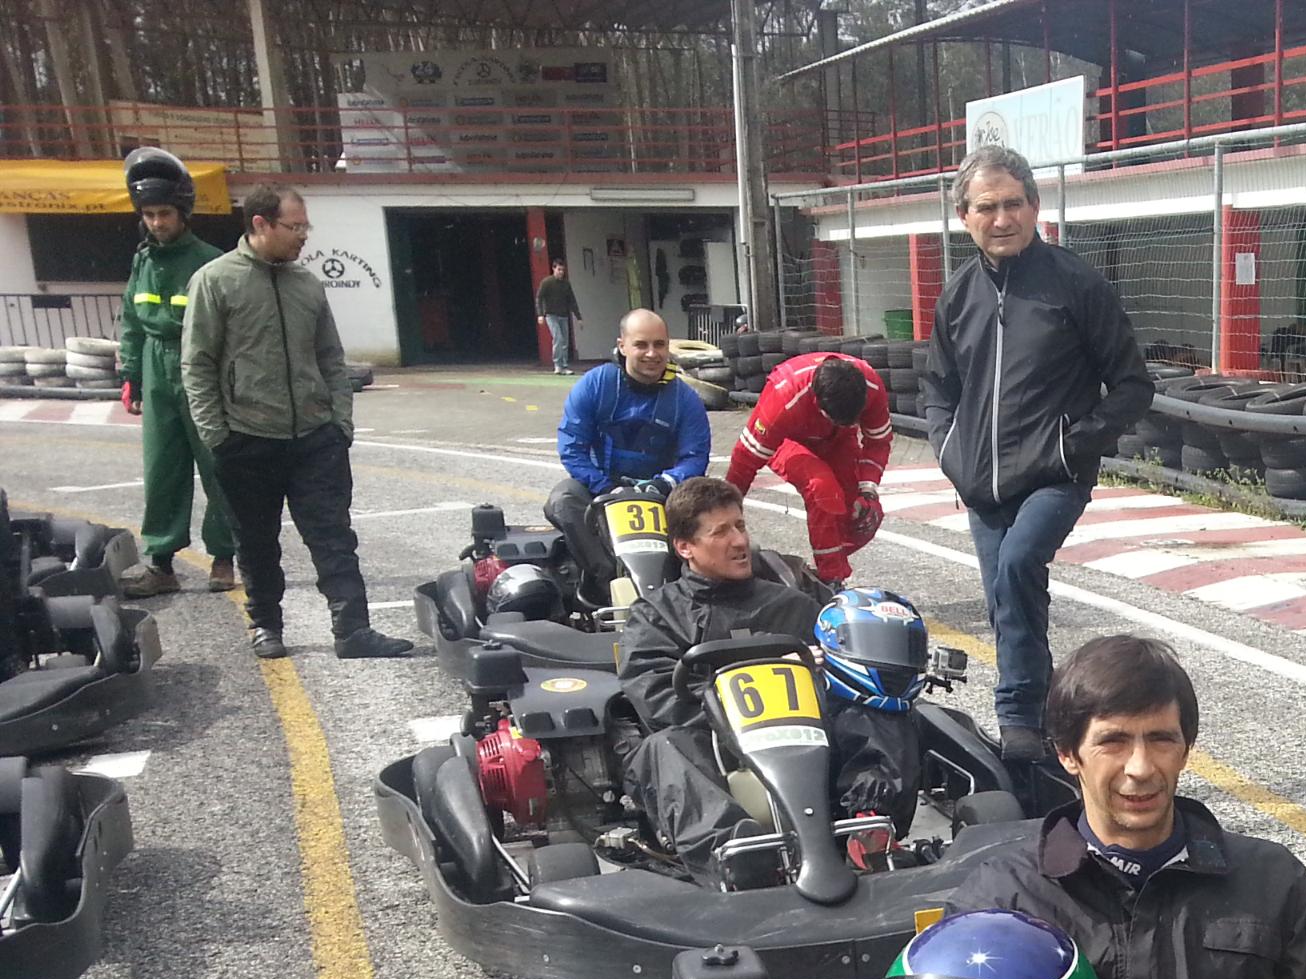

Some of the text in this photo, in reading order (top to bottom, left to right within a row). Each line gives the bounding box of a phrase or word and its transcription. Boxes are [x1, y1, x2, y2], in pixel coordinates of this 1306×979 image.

[300, 248, 382, 288] OLA KARTING
[626, 504, 661, 532] 31
[880, 605, 909, 618] BELL
[729, 667, 800, 719] 67
